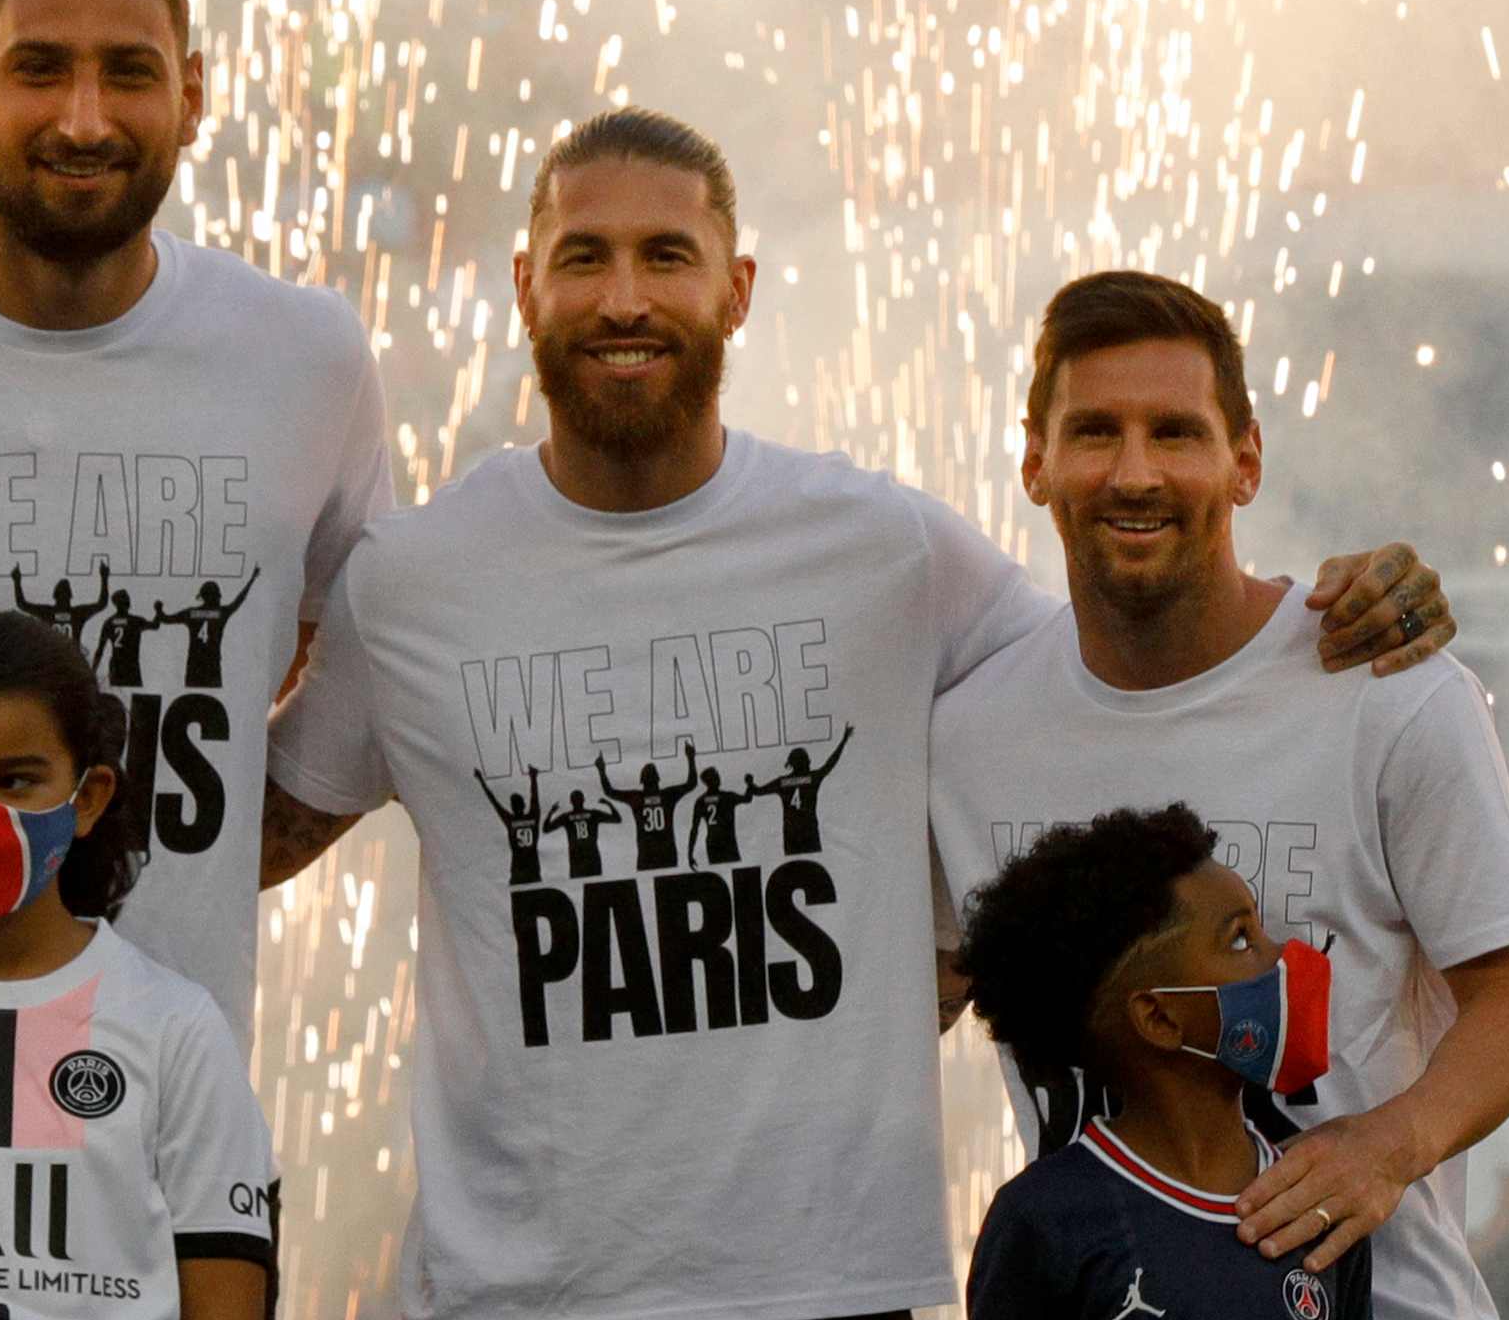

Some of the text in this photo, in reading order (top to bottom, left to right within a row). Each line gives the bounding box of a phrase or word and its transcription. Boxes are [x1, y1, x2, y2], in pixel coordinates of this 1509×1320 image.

[66, 453, 248, 579] ARE
[114, 628, 124, 648] 2
[197, 620, 208, 644] 4
[461, 618, 833, 779] WE ARE
[790, 787, 802, 810] 4
[643, 806, 665, 832] 30
[707, 804, 717, 826] 2
[516, 828, 534, 848] 50
[575, 818, 589, 839] 18
[510, 859, 842, 1047] PARIS
[67, 1058, 110, 1076] PARIS
[18, 1268, 140, 1300] LIMITLESS
